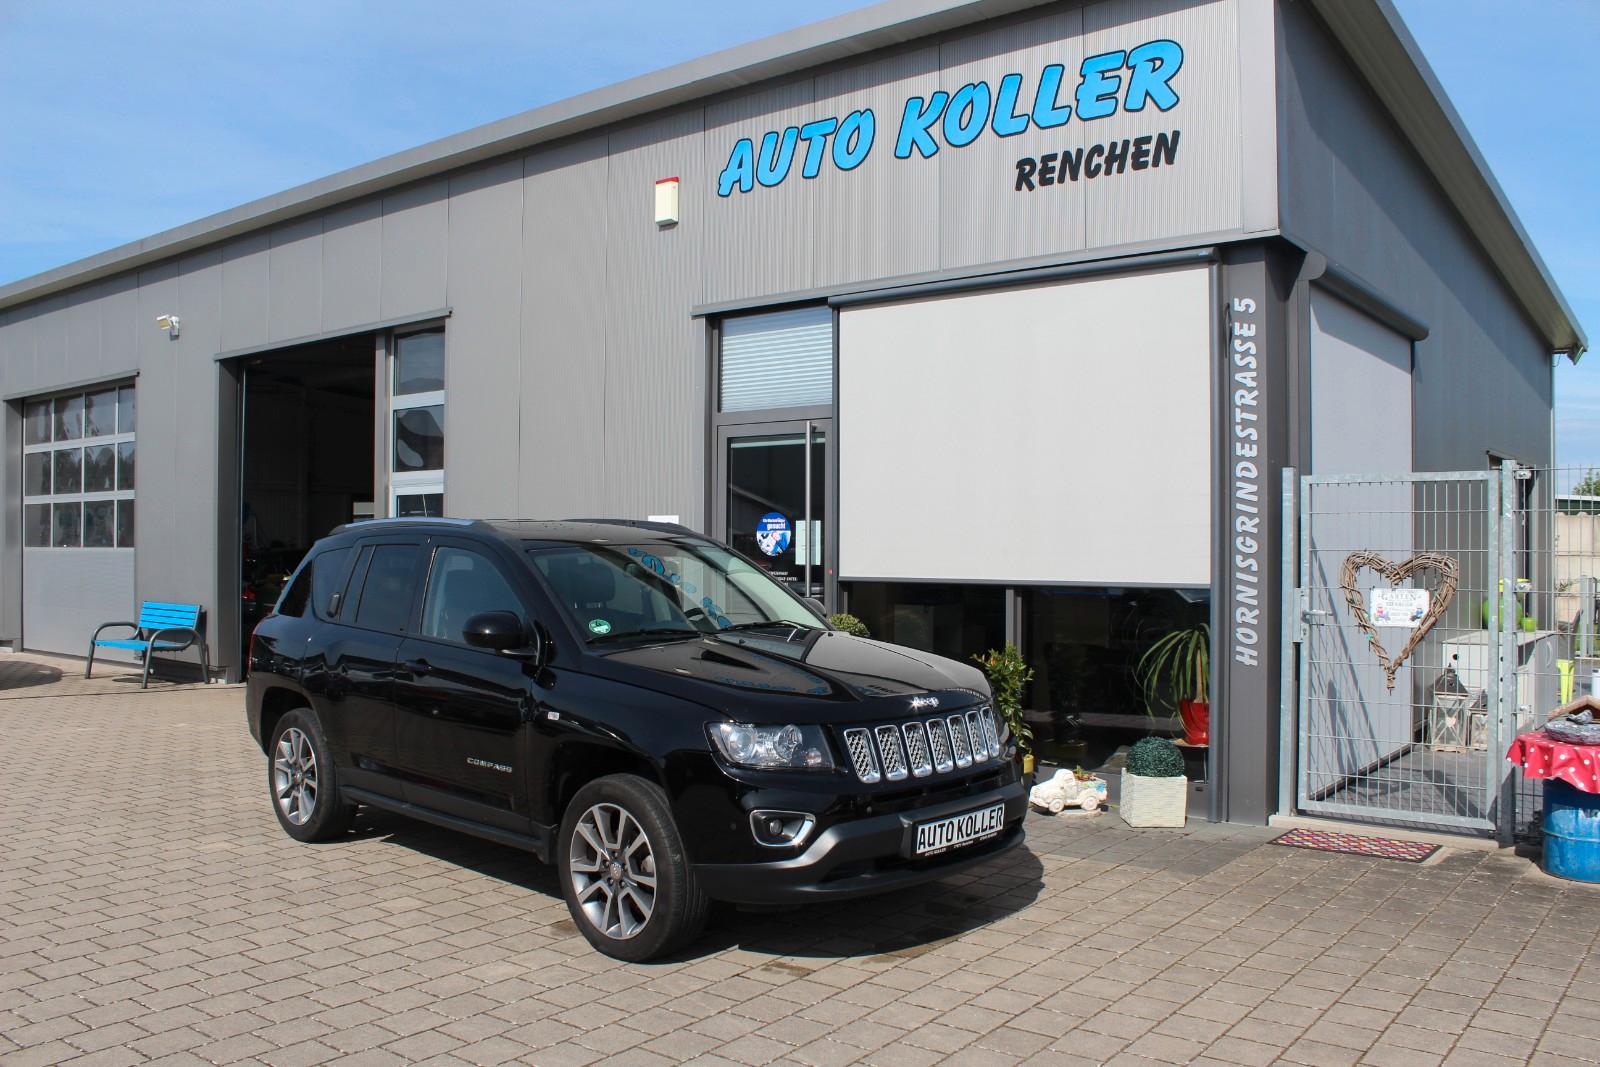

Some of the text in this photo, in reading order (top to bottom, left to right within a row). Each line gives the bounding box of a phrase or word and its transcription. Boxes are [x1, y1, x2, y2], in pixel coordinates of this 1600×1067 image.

[718, 39, 1184, 197] AUTO KOLLER
[1015, 130, 1181, 191] RENCHEN
[1233, 297, 1260, 668] HORNISGRINDESTRASSE 5
[466, 757, 513, 773] COMPASS
[918, 807, 1003, 850] AUTO KOLLER
